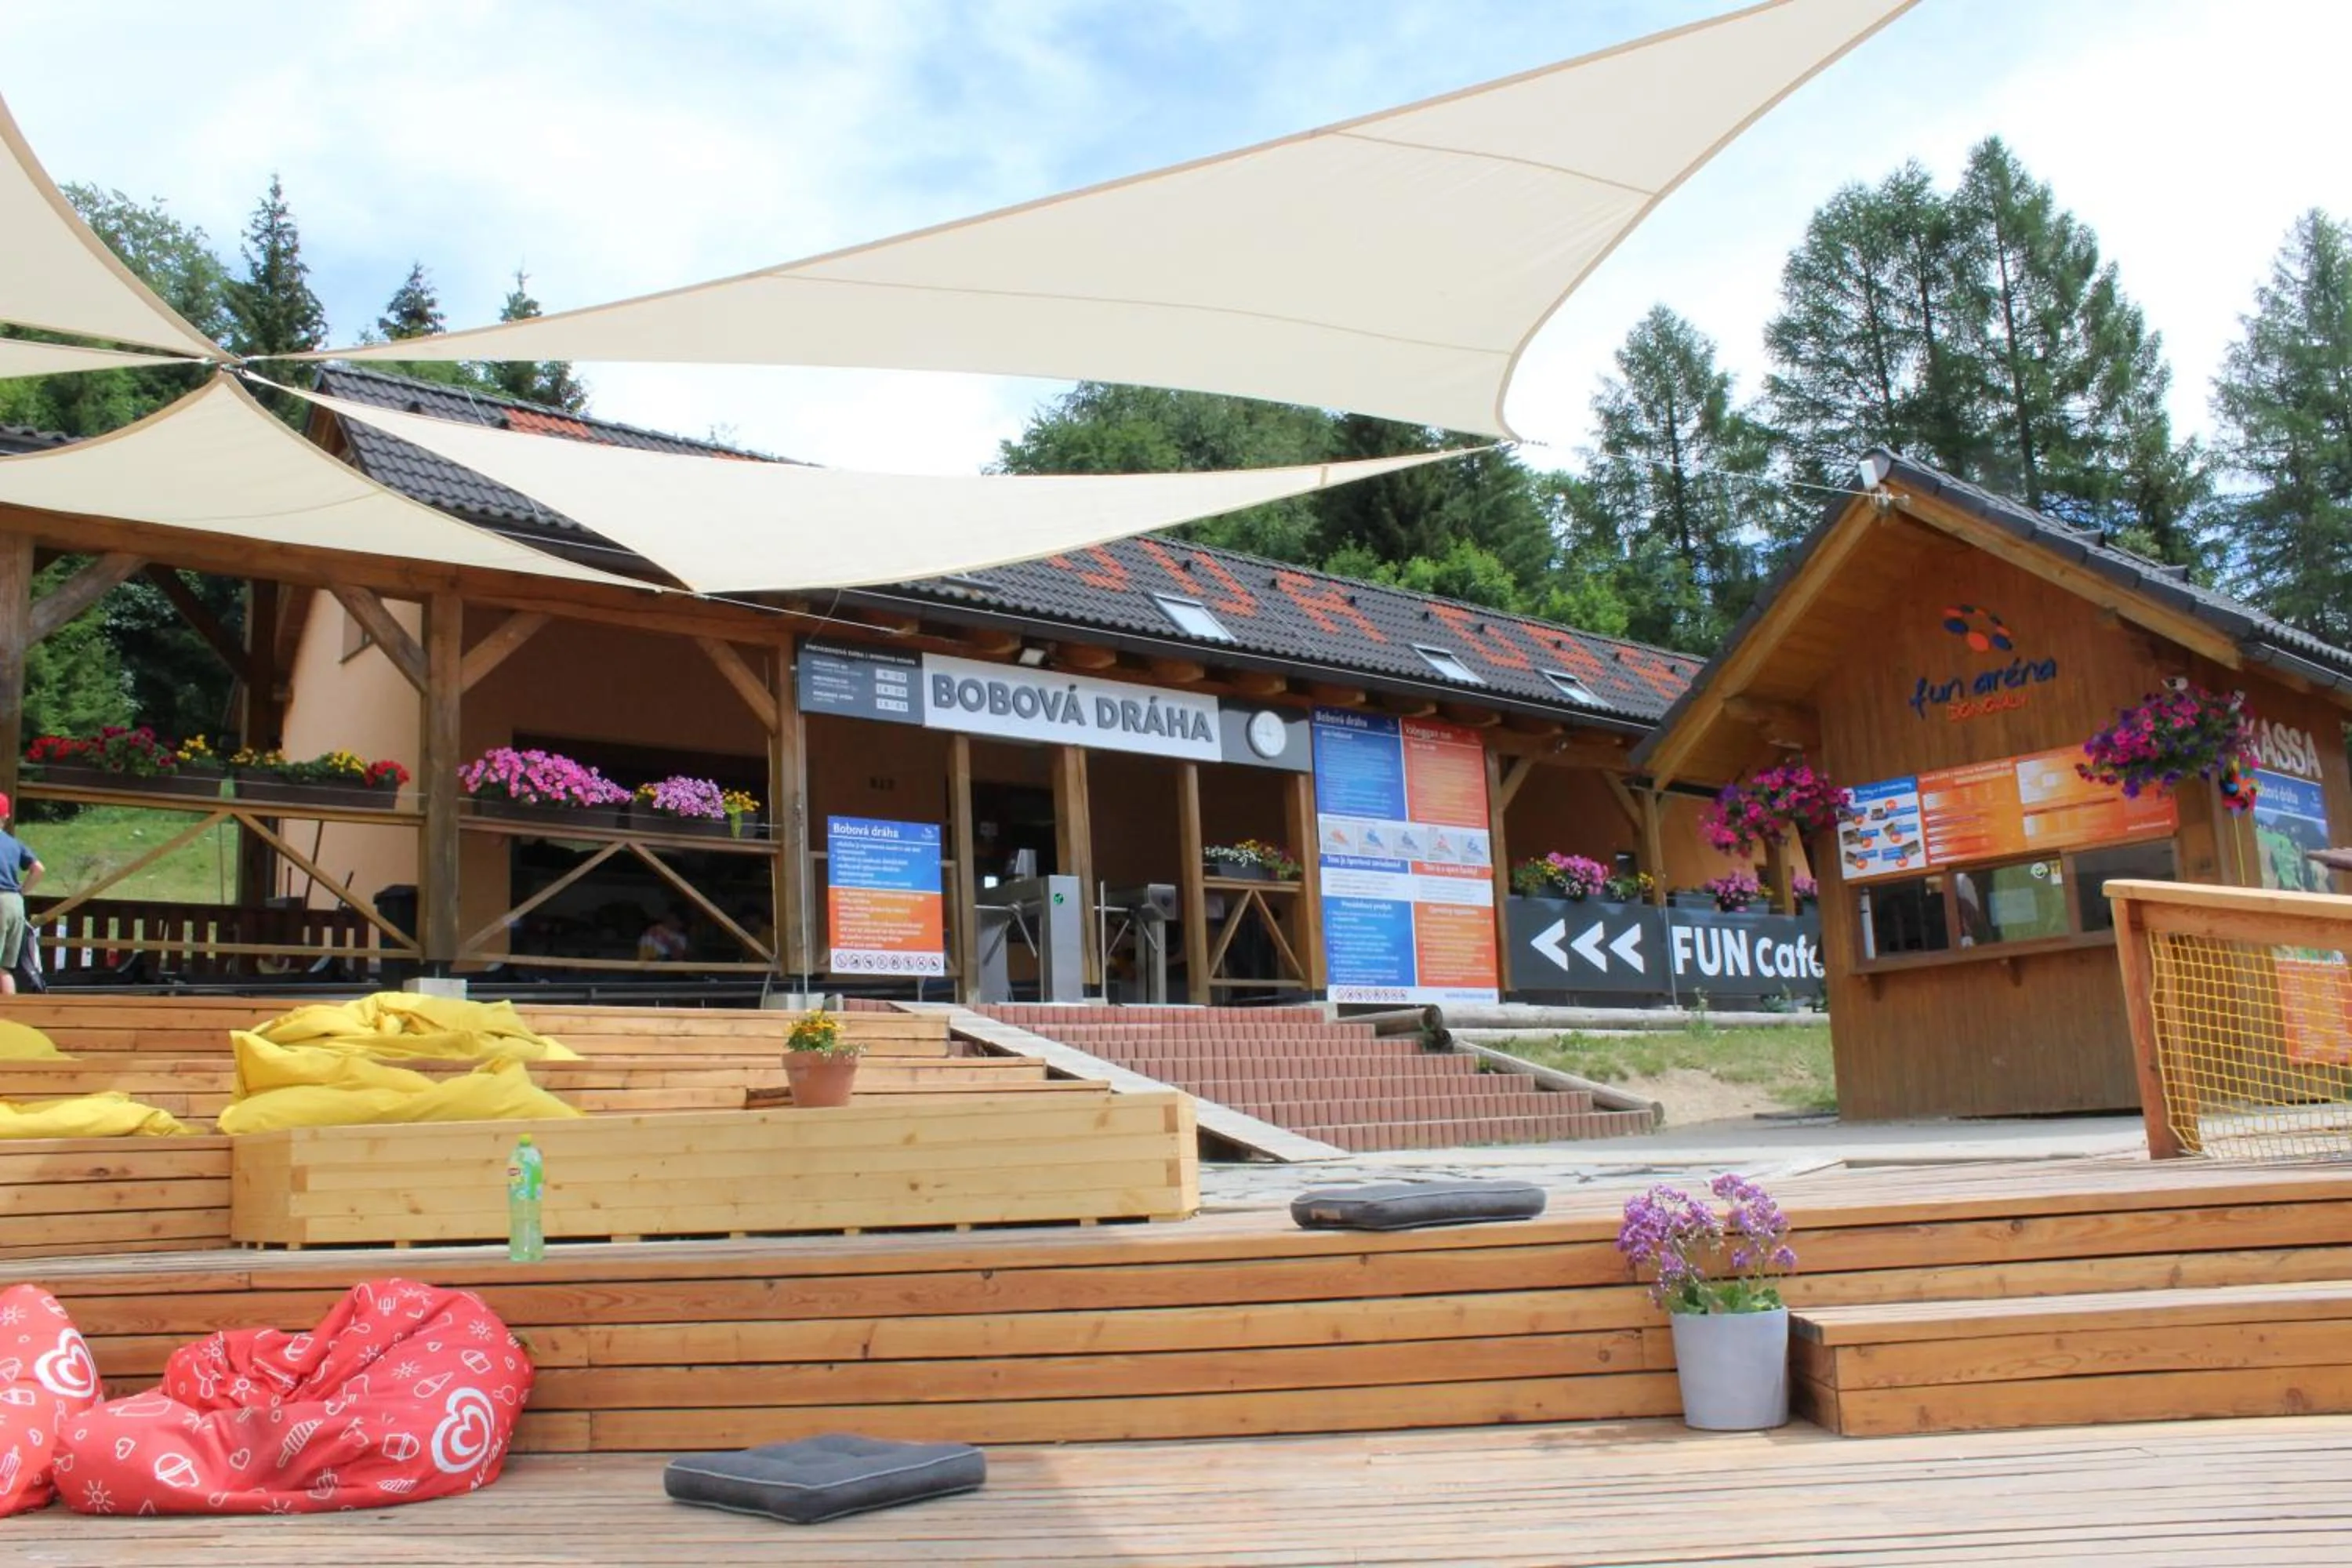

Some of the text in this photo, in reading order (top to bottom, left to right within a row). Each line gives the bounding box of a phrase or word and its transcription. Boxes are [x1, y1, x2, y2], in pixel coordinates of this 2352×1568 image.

[931, 673, 1087, 727] BOBOVÁ
[1095, 695, 1214, 742] DRÁHA
[1908, 677, 1965, 721] fun
[833, 822, 900, 839] Bobová dráha
[1671, 925, 1752, 978] FUN
